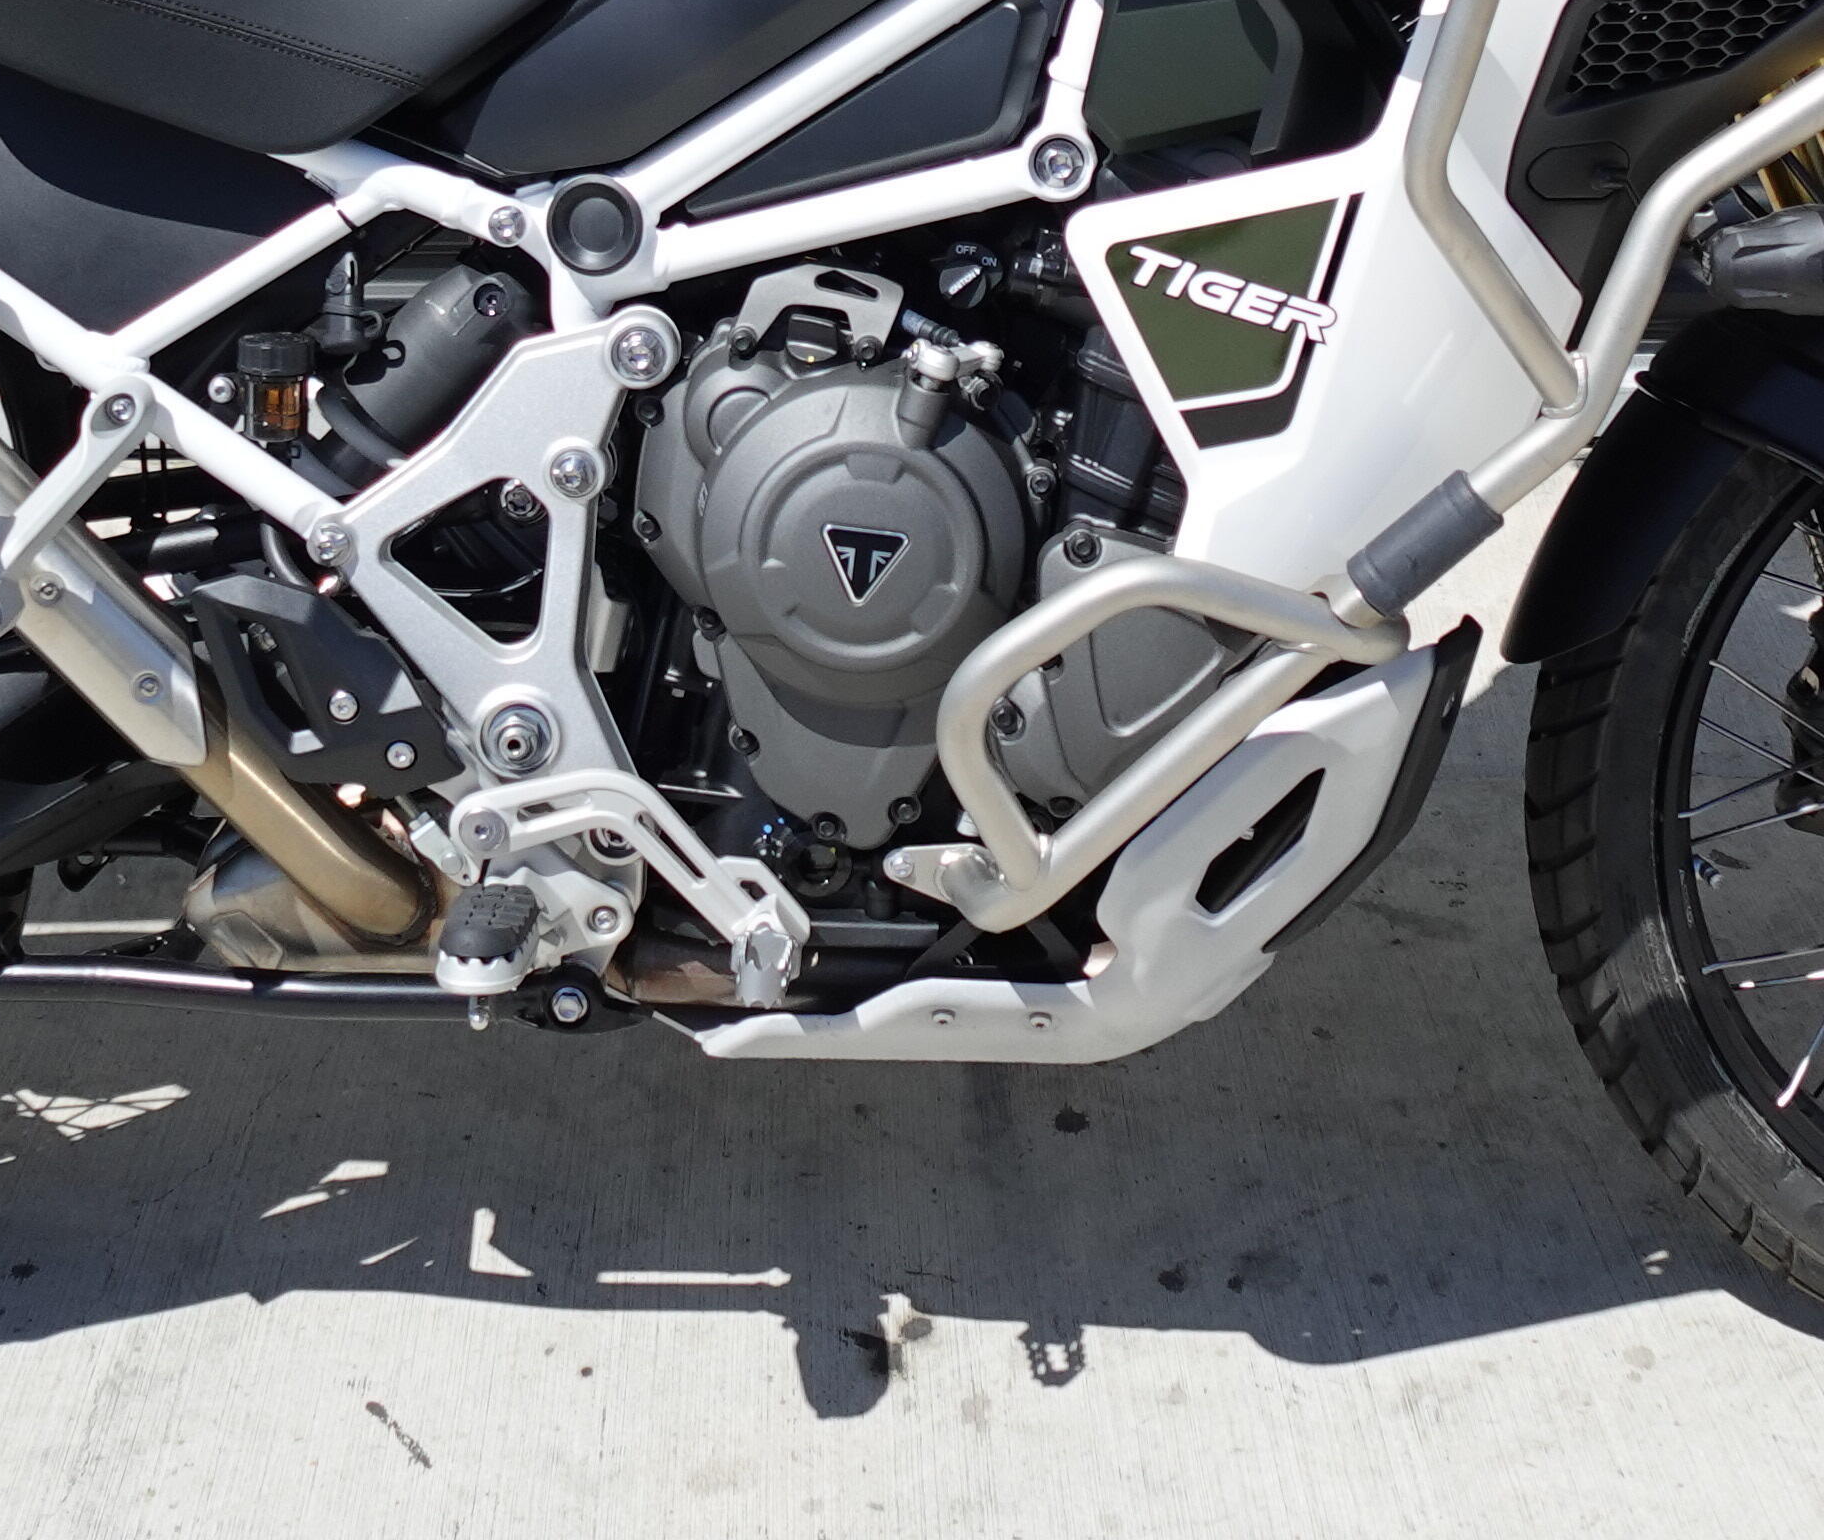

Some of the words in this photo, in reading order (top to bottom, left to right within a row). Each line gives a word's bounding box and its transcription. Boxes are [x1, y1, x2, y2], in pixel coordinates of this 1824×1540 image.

[955, 243, 978, 256] OFF
[981, 256, 998, 268] ON
[1128, 244, 1338, 344] TIGER
